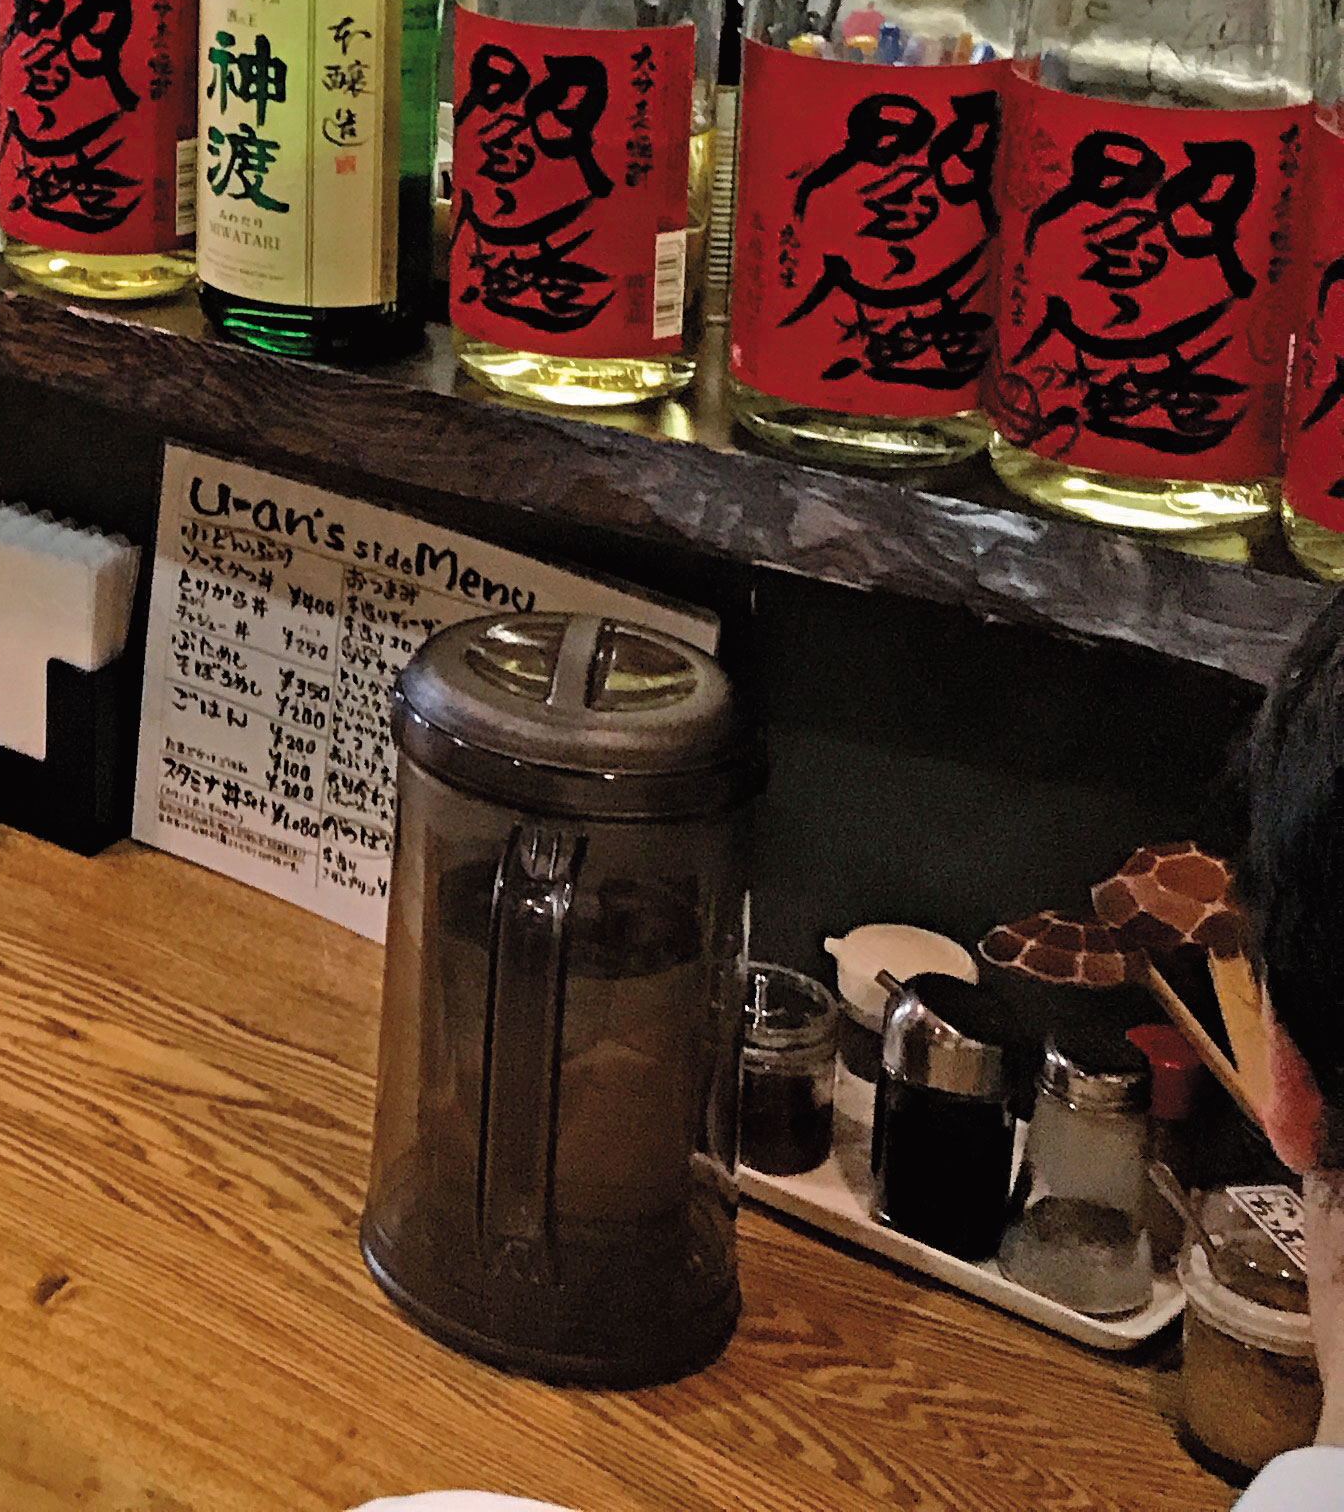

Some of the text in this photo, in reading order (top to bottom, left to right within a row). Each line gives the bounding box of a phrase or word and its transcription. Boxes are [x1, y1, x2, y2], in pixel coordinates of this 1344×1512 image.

[206, 30, 291, 215] 神渡
[320, 16, 376, 148] 本醸造
[189, 476, 536, 615] U-an's side Menu
[171, 685, 249, 729] ごはん
